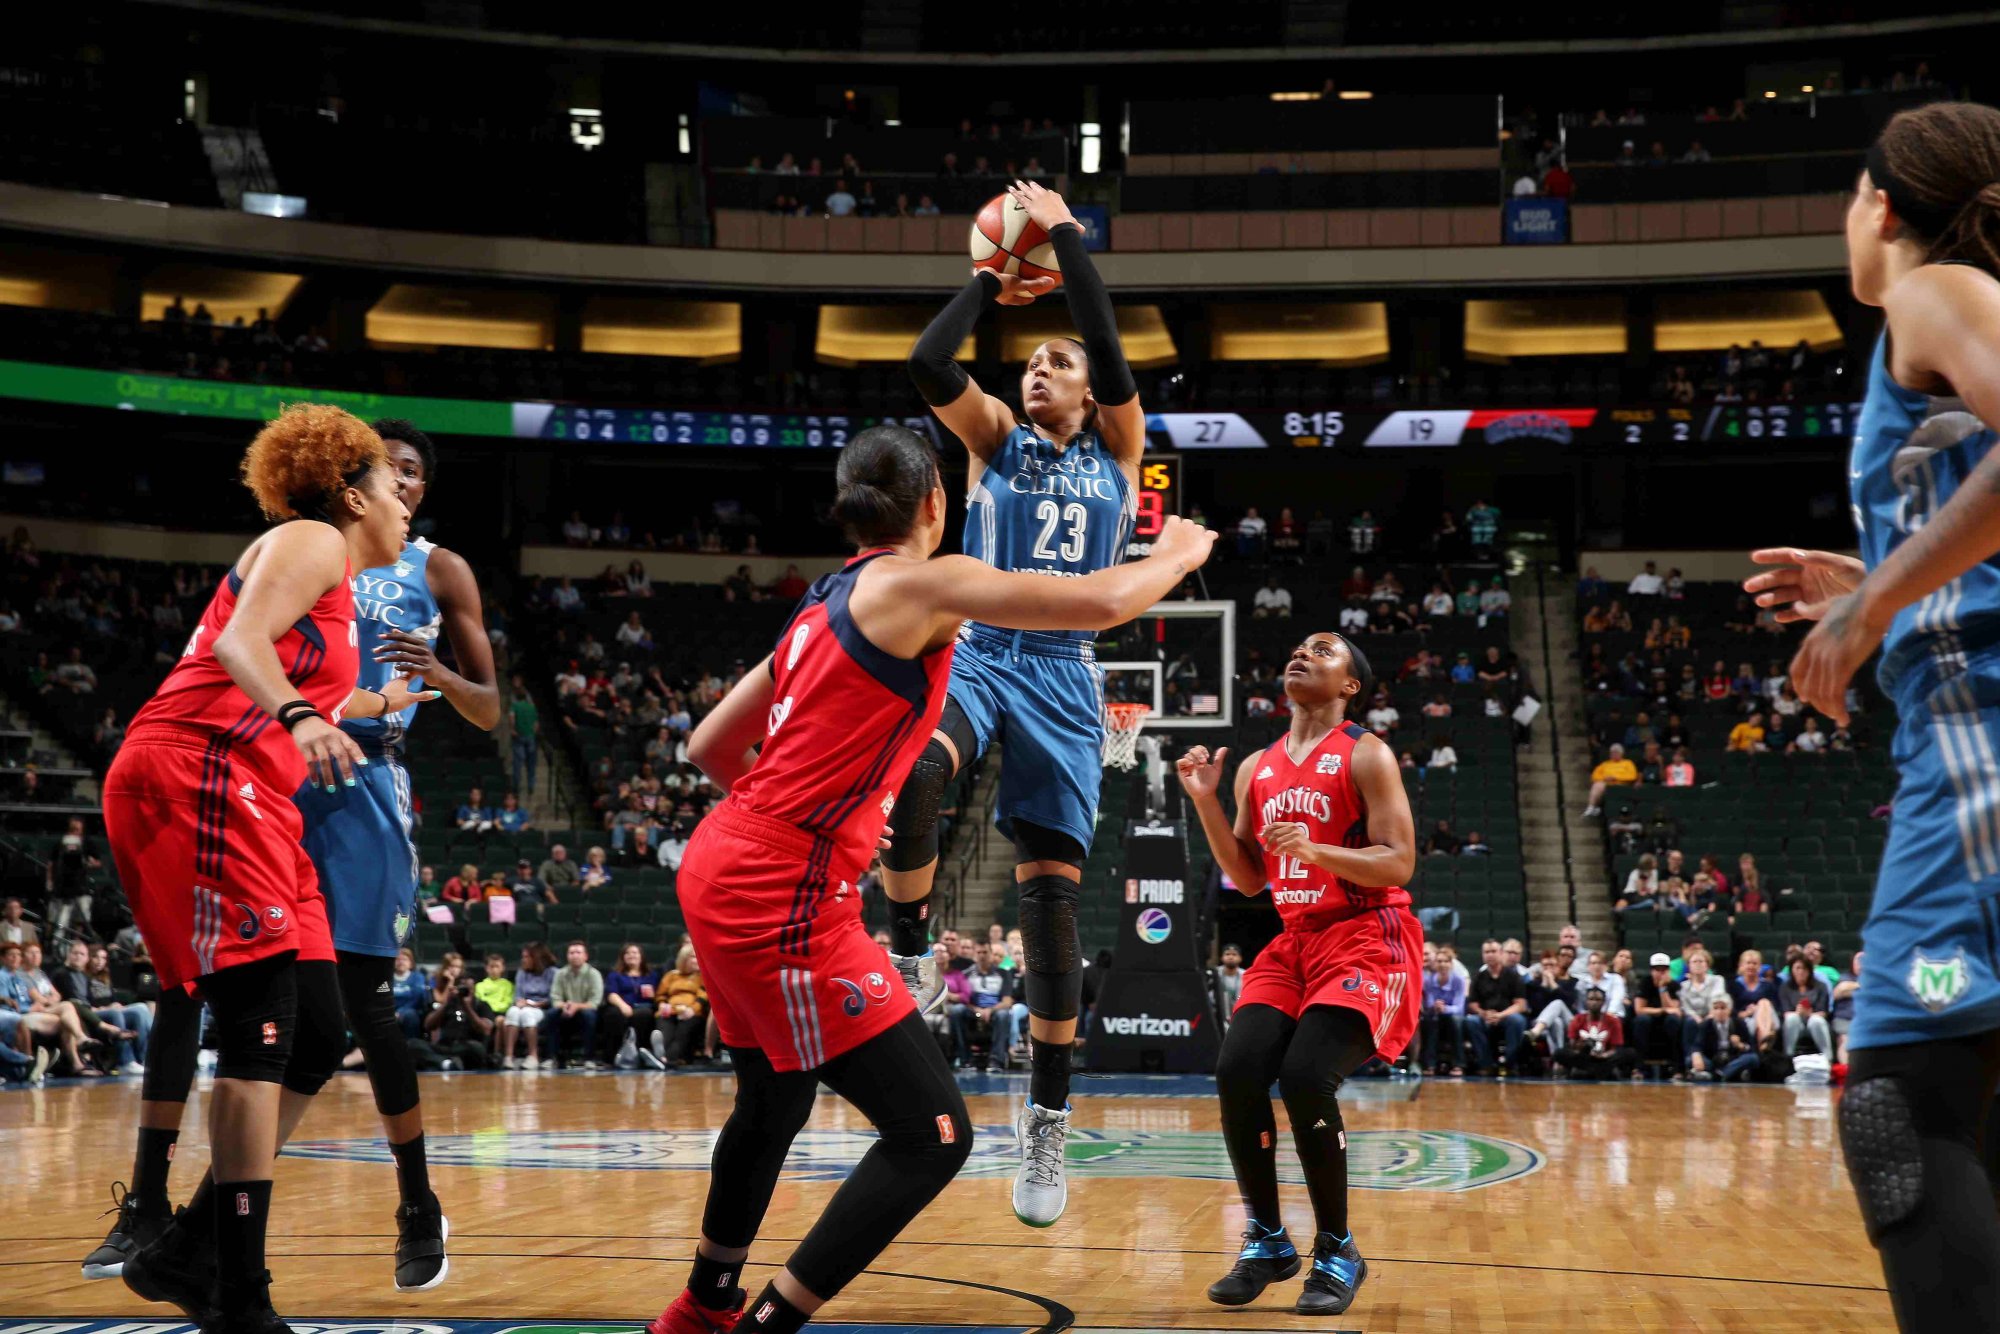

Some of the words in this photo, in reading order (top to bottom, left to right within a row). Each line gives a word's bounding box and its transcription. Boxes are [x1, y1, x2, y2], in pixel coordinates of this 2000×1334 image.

[575, 421, 592, 440] 0
[600, 423, 616, 441] 4
[652, 424, 669, 443] 0
[676, 425, 693, 444] 2
[730, 427, 747, 446] 0
[807, 429, 823, 447] 0
[1194, 420, 1226, 443] 27
[1283, 411, 1345, 437] 8:15
[1408, 418, 1434, 441] 19
[1625, 423, 1642, 443] 2
[1673, 420, 1690, 441] 2
[1724, 418, 1741, 438] 4
[1746, 418, 1764, 438] 0
[1770, 418, 1788, 438] 2
[1021, 454, 1100, 475] MAYO
[1009, 472, 1113, 501] CLINIC
[1033, 500, 1088, 562] 23
[353, 595, 405, 628] NIC
[1139, 879, 1184, 904] PRIDE
[1274, 886, 1319, 906] erizon
[1102, 1013, 1191, 1037] verizon
